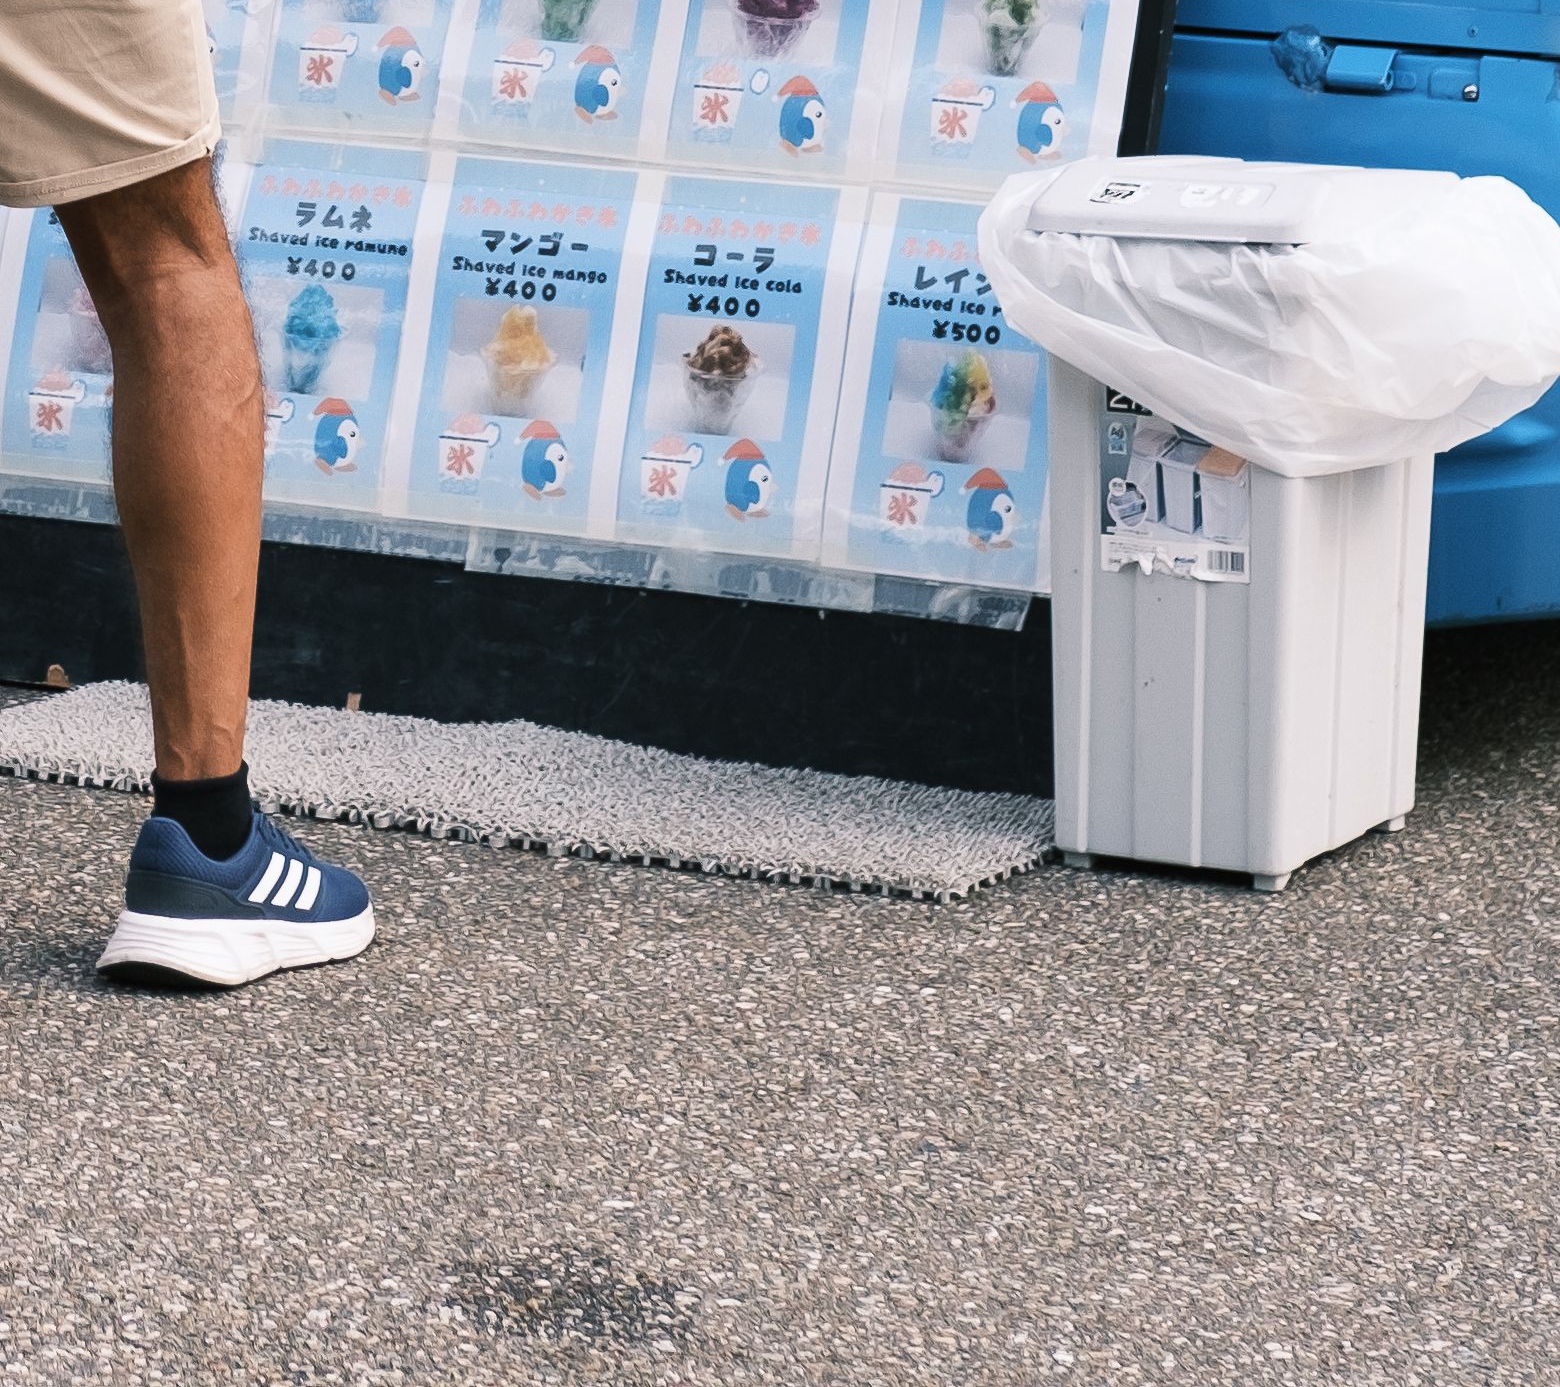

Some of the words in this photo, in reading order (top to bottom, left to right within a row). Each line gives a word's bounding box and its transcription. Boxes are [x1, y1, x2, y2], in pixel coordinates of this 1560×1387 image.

[701, 93, 728, 125] 氷
[939, 107, 969, 139] 氷
[287, 256, 355, 281] ¥400
[486, 278, 557, 303] ¥400
[687, 293, 760, 319] ¥400
[932, 319, 1001, 345] ¥500
[648, 466, 677, 497] 氷
